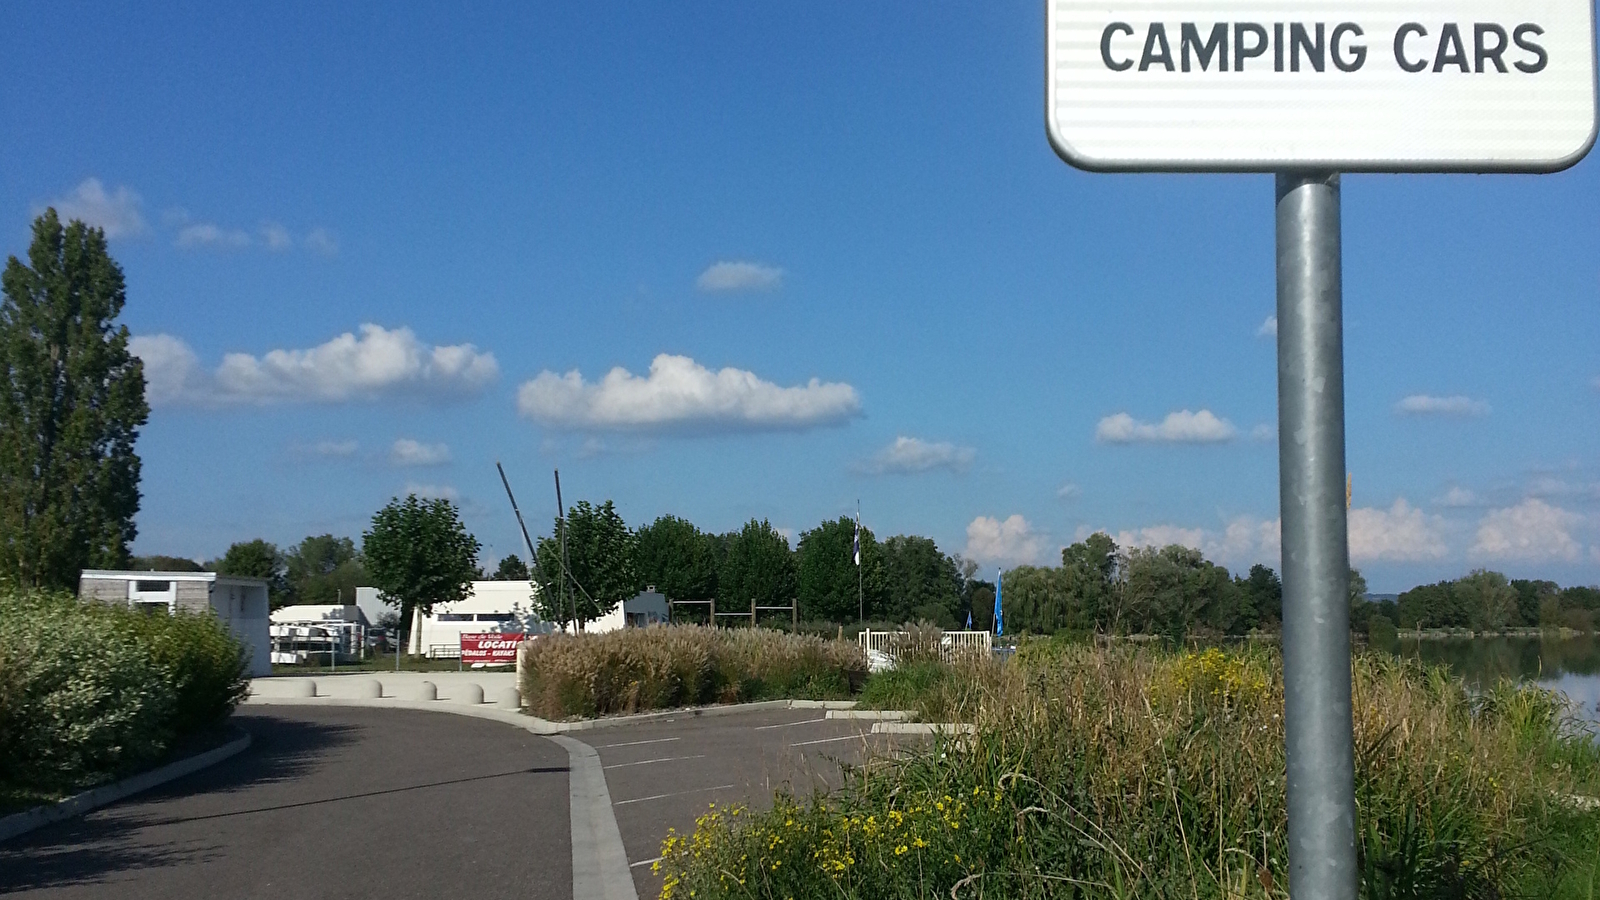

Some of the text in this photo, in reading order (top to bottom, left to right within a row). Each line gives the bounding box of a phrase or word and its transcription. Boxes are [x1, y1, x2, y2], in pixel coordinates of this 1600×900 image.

[1100, 22, 1548, 73] CAMPING CARS
[478, 640, 517, 649] LOCATI
